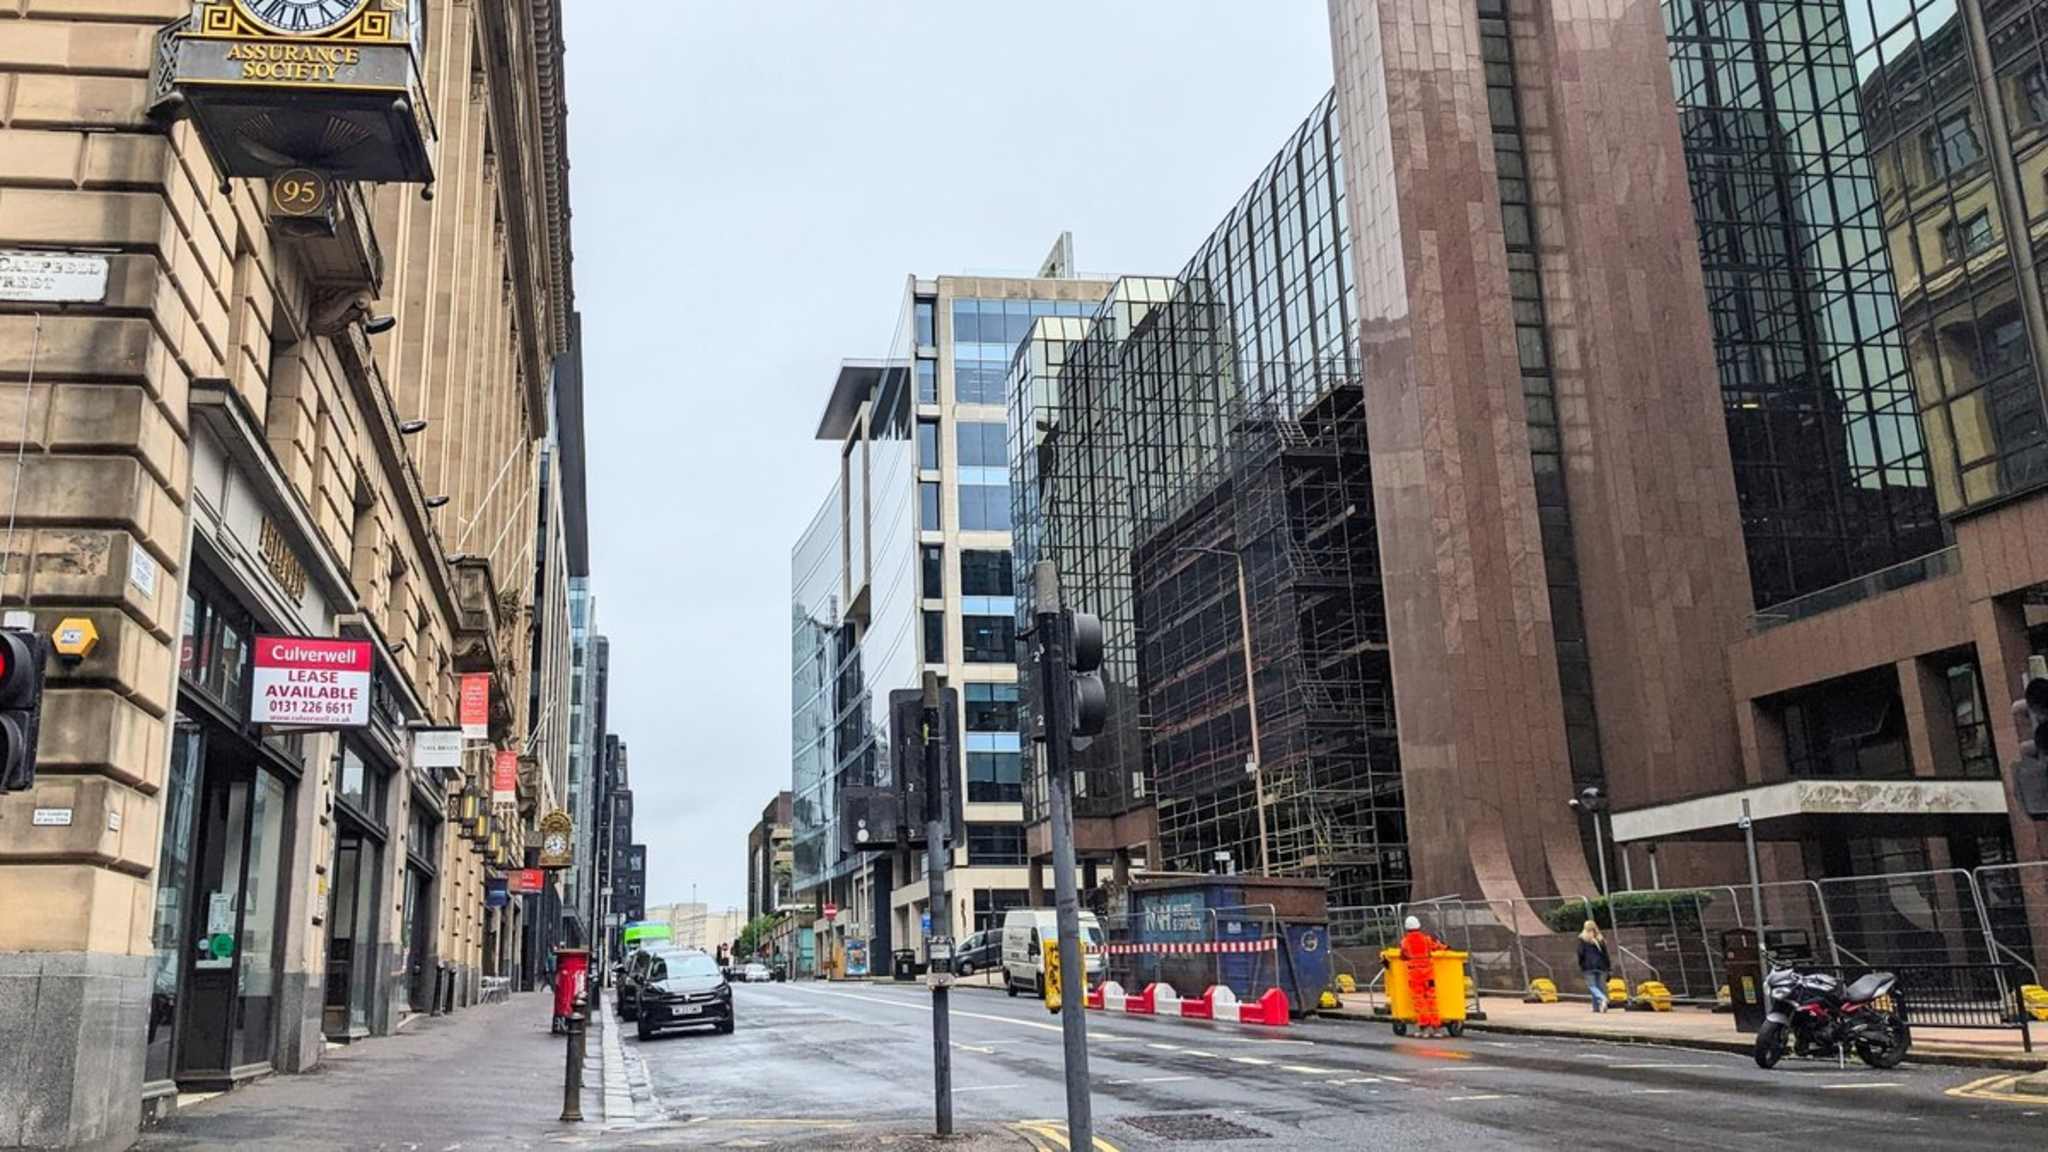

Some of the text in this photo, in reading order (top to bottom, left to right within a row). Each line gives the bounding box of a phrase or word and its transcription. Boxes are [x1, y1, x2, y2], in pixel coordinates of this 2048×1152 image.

[226, 44, 360, 64] ASSURANCE
[243, 61, 339, 81] SOCIETY
[283, 180, 315, 202] 95
[271, 644, 357, 664] Culverwell
[288, 670, 339, 683] LEASE
[265, 685, 358, 699] AVAILABLE
[269, 700, 353, 714] 0131 226 6611
